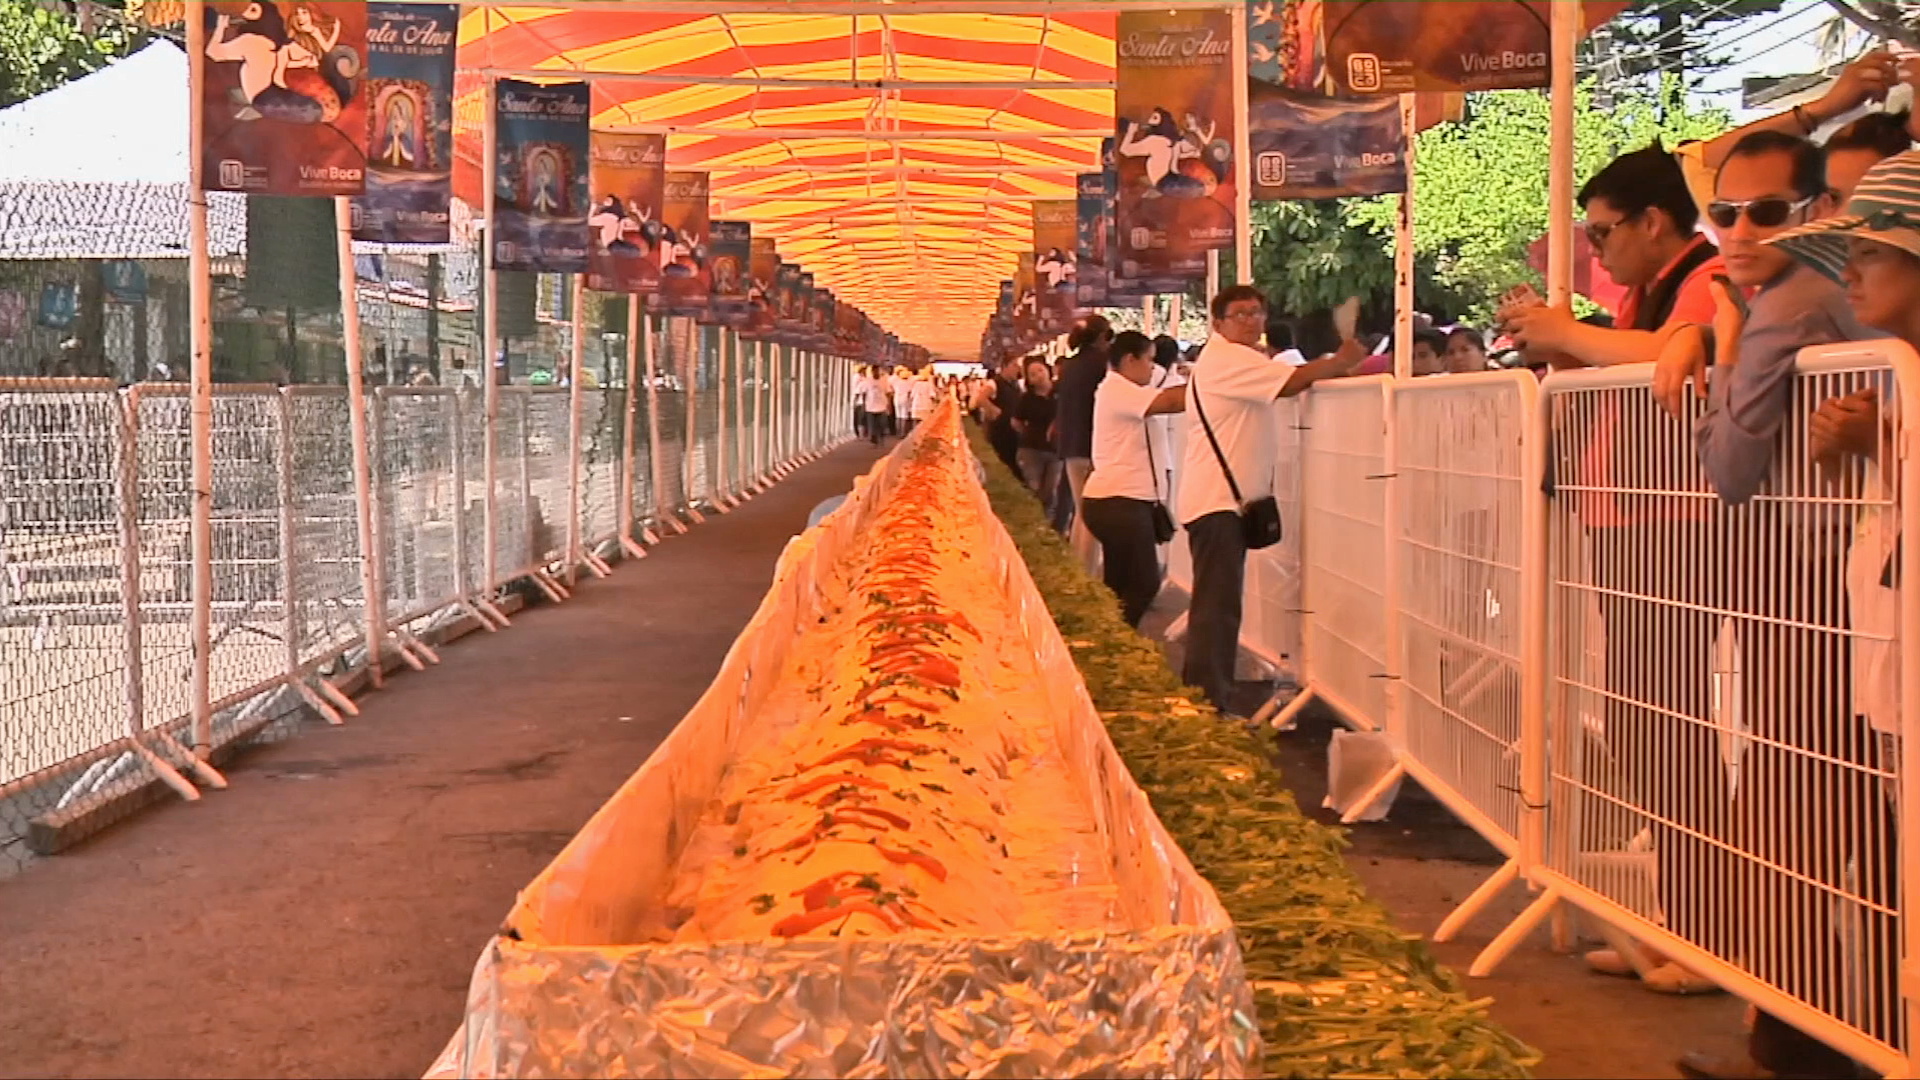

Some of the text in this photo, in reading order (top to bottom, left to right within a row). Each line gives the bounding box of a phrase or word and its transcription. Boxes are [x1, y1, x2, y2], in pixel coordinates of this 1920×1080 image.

[403, 20, 452, 45] Ana
[1119, 30, 1230, 57] Santa Ana
